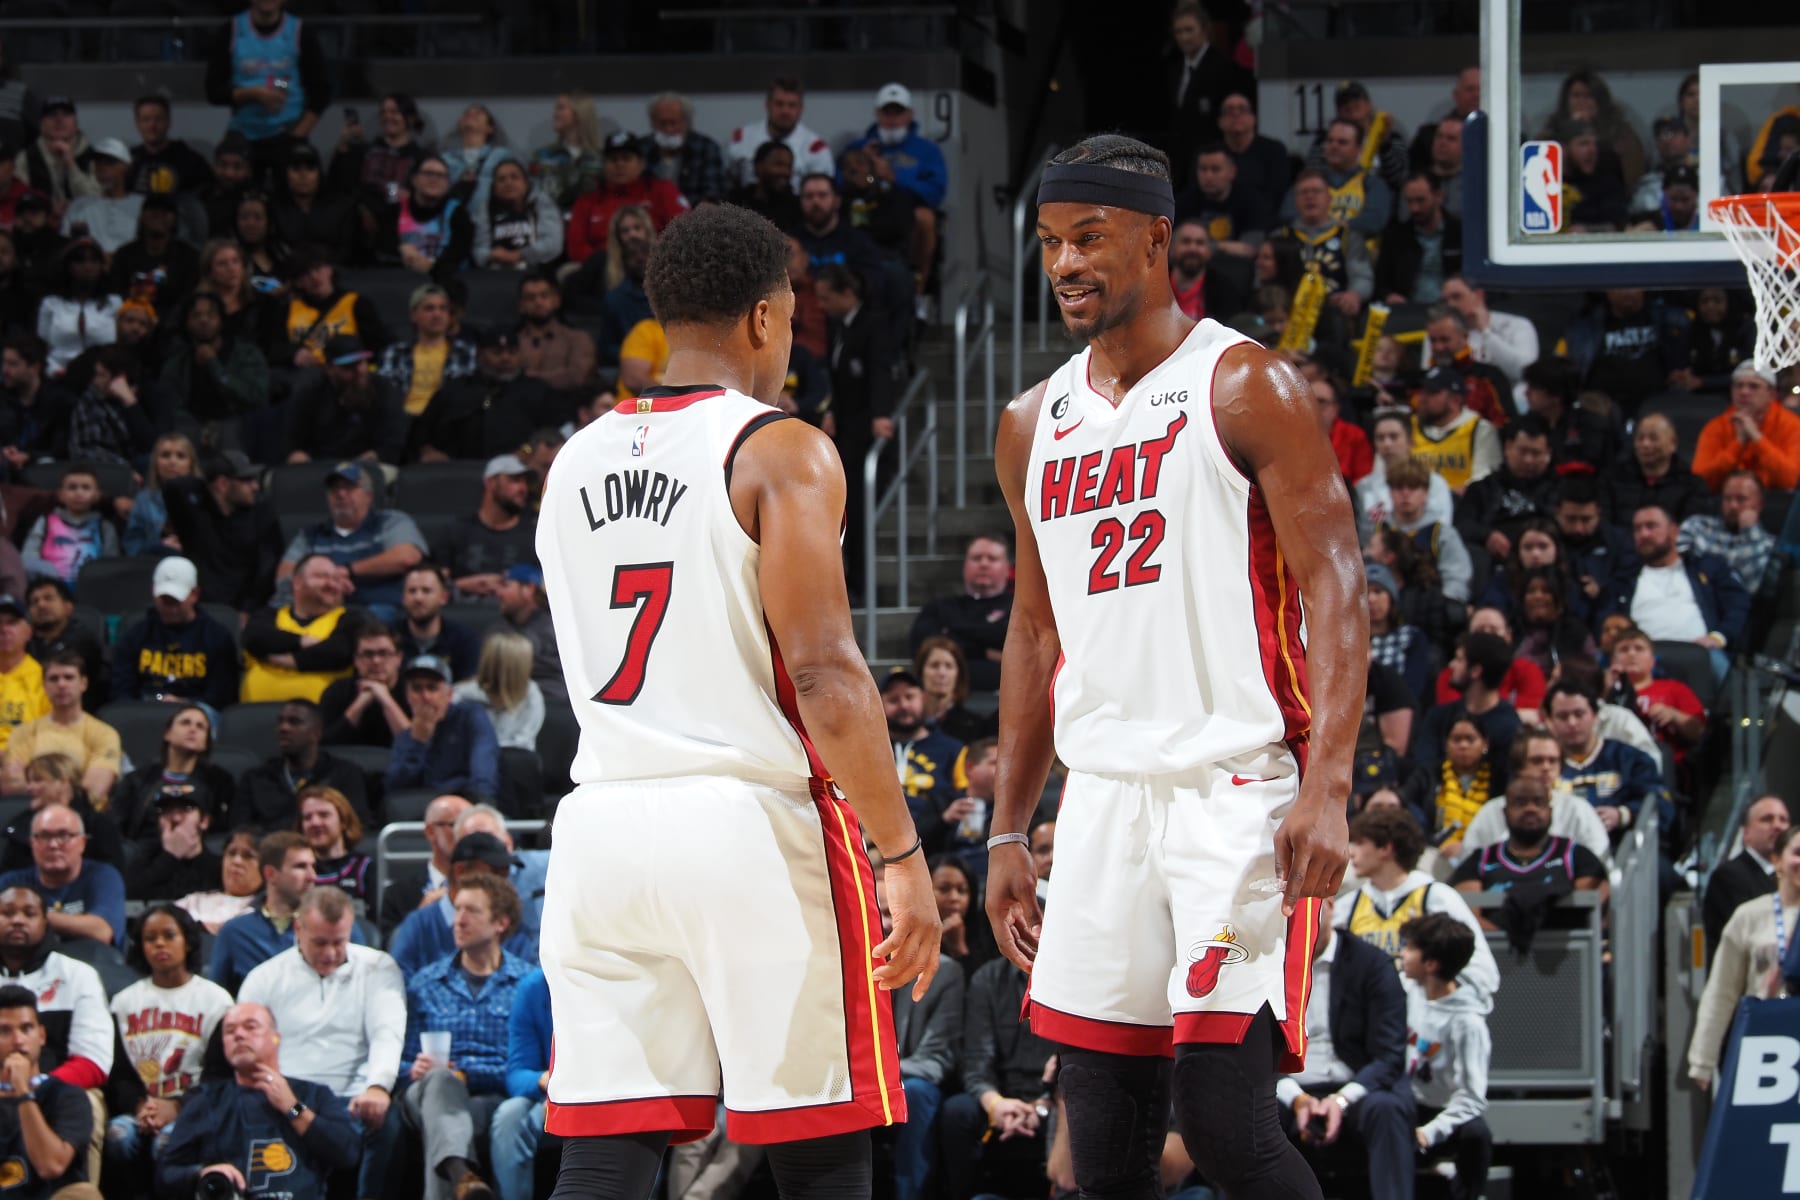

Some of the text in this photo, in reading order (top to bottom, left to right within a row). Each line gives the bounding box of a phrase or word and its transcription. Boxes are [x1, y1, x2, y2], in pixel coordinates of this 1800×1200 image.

[935, 91, 953, 143] 9
[579, 469, 688, 532] LOWRY
[1041, 410, 1188, 522] HEAT
[1087, 508, 1167, 596] 22
[139, 648, 207, 678] PACERS
[590, 560, 674, 706] 7
